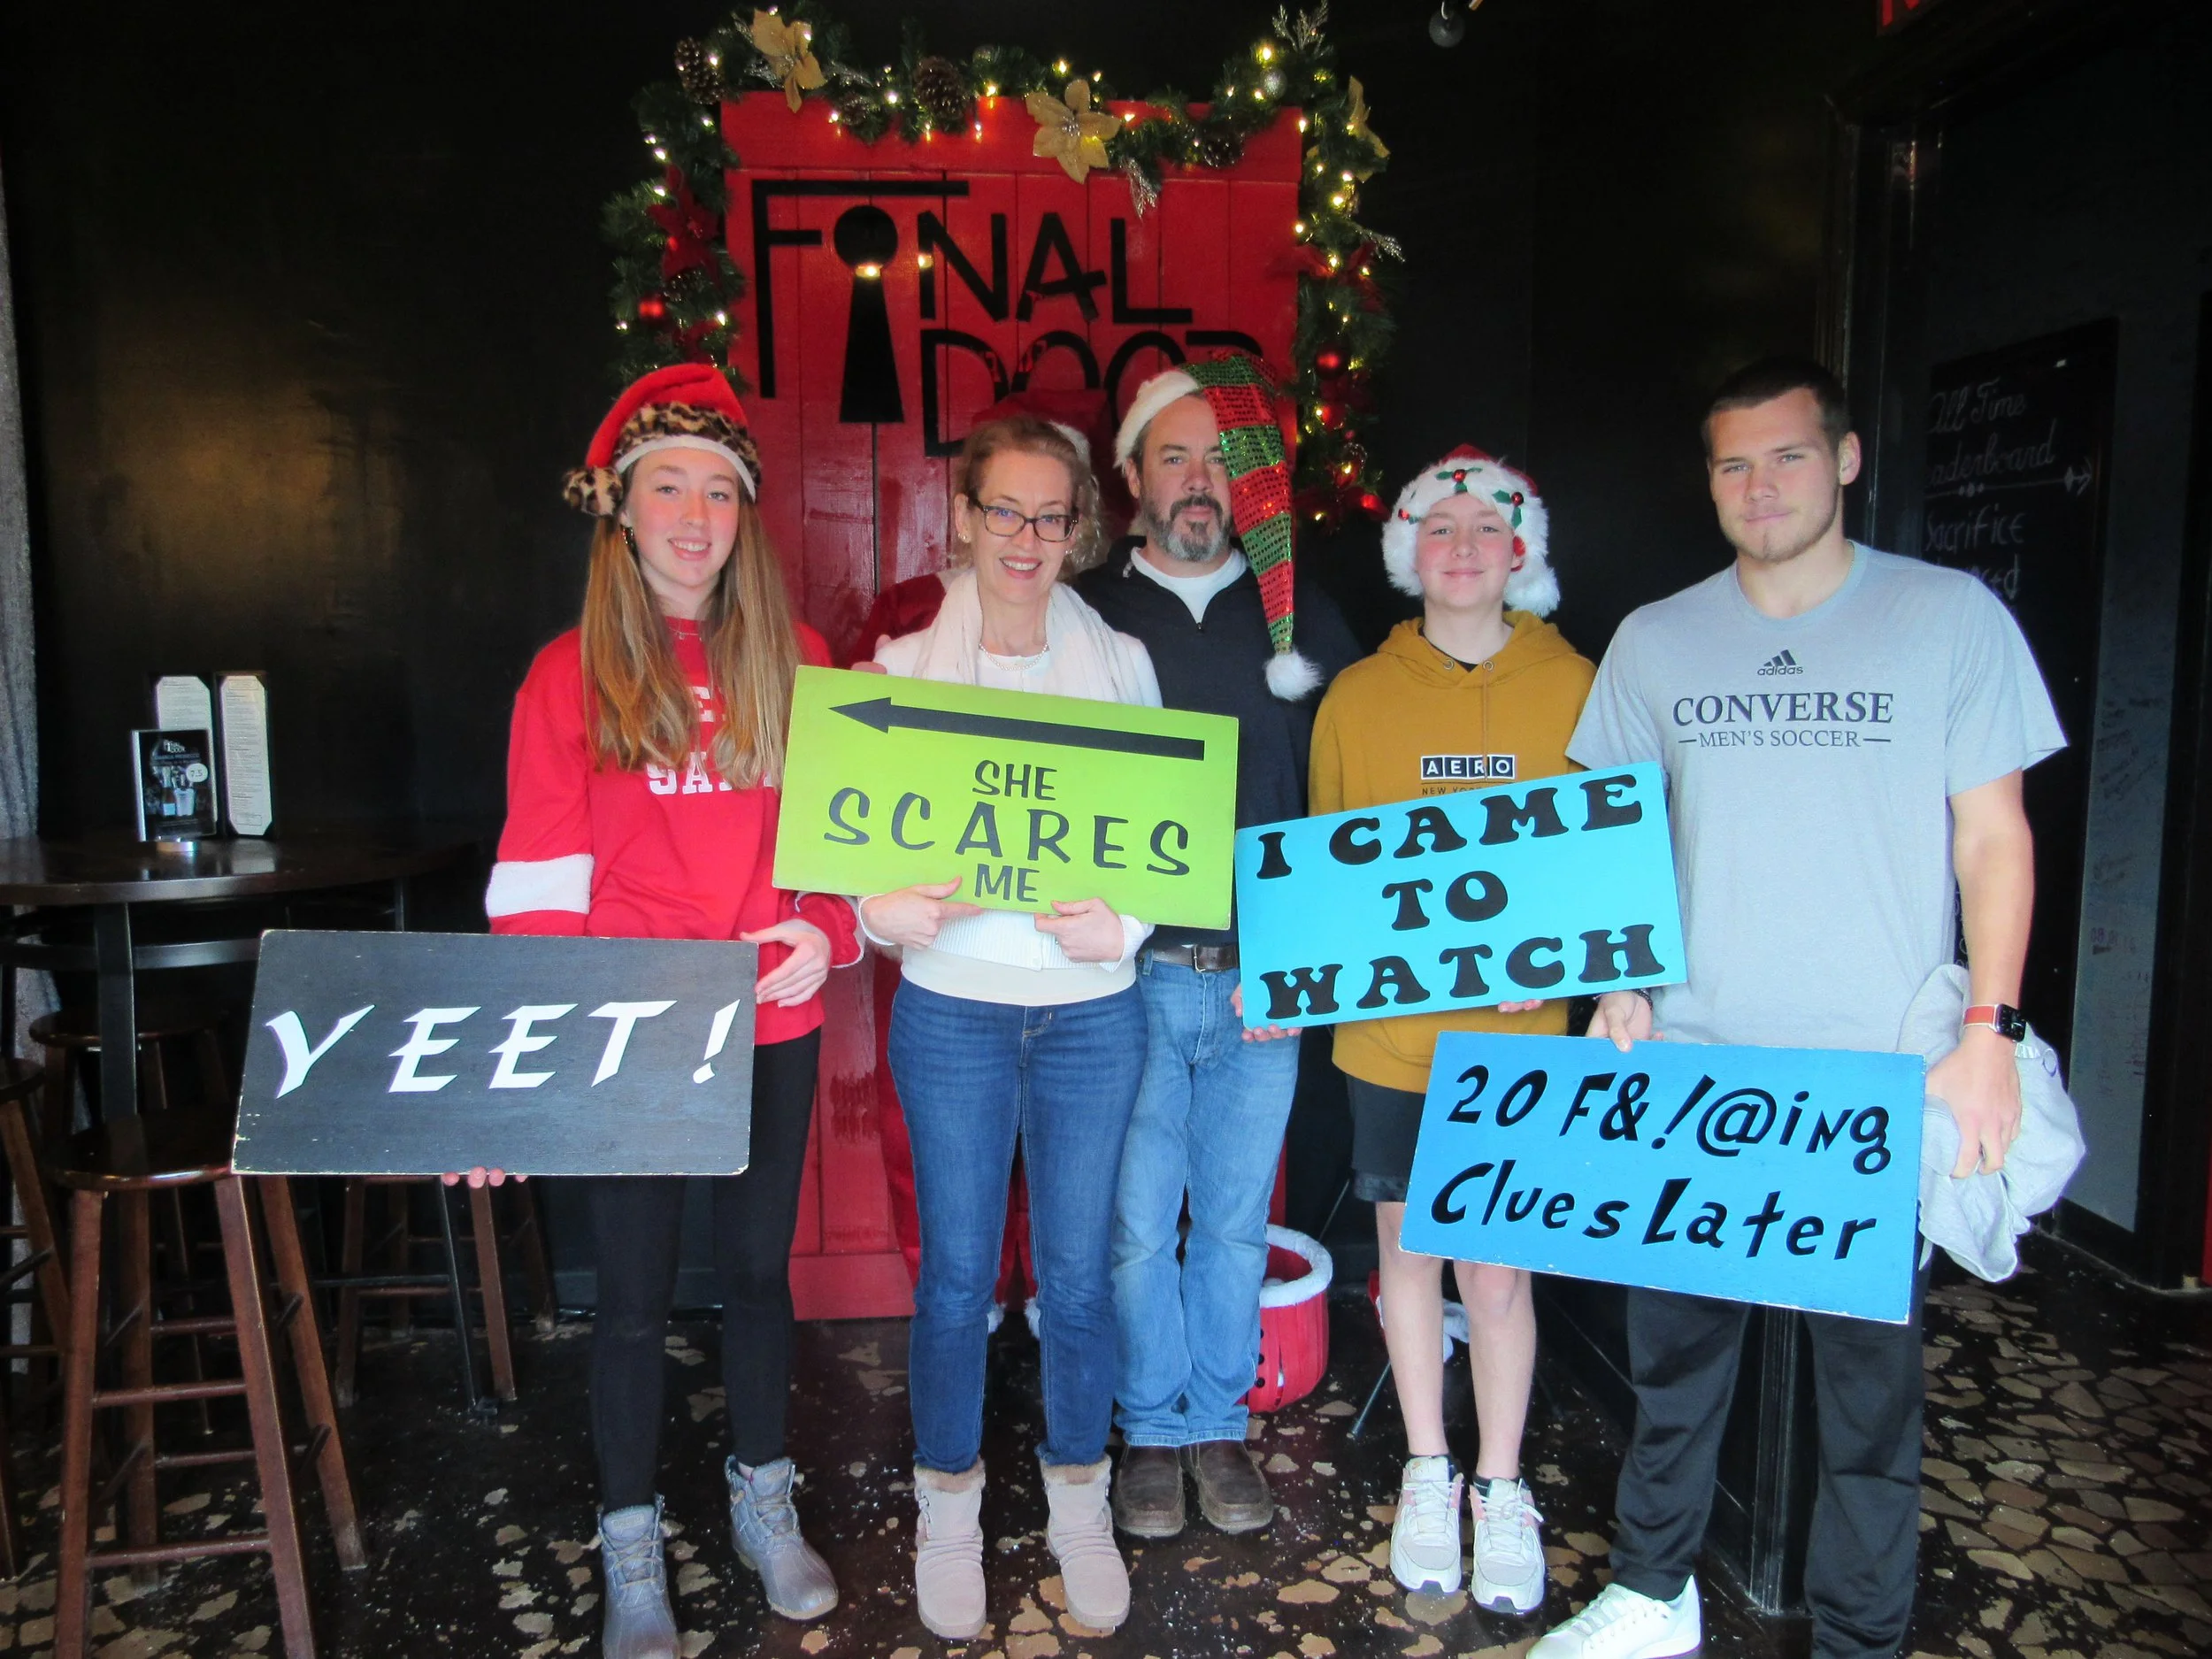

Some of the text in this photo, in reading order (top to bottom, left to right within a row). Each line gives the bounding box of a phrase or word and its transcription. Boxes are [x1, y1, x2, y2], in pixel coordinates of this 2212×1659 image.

[751, 180, 1193, 423] FINAL
[1970, 376, 2027, 424] Time
[1928, 417, 2057, 486] aderboard
[1757, 664, 1803, 676] adidas
[1673, 691, 1893, 726] CONVERSE
[1700, 729, 1862, 748] MEN'S SOCCER
[972, 759, 1058, 801] SHE
[1422, 787, 1447, 795] NEW
[1425, 759, 1510, 775] AERO
[824, 787, 1190, 876] SCARES
[1256, 773, 1643, 879] I CAME
[974, 864, 1040, 902] ME
[1381, 870, 1509, 932] TO
[1259, 924, 1665, 1020] WATCH
[265, 998, 741, 1100] YEET!
[1447, 1064, 1548, 1127] 20
[1431, 1159, 1878, 1261] Clues Later
